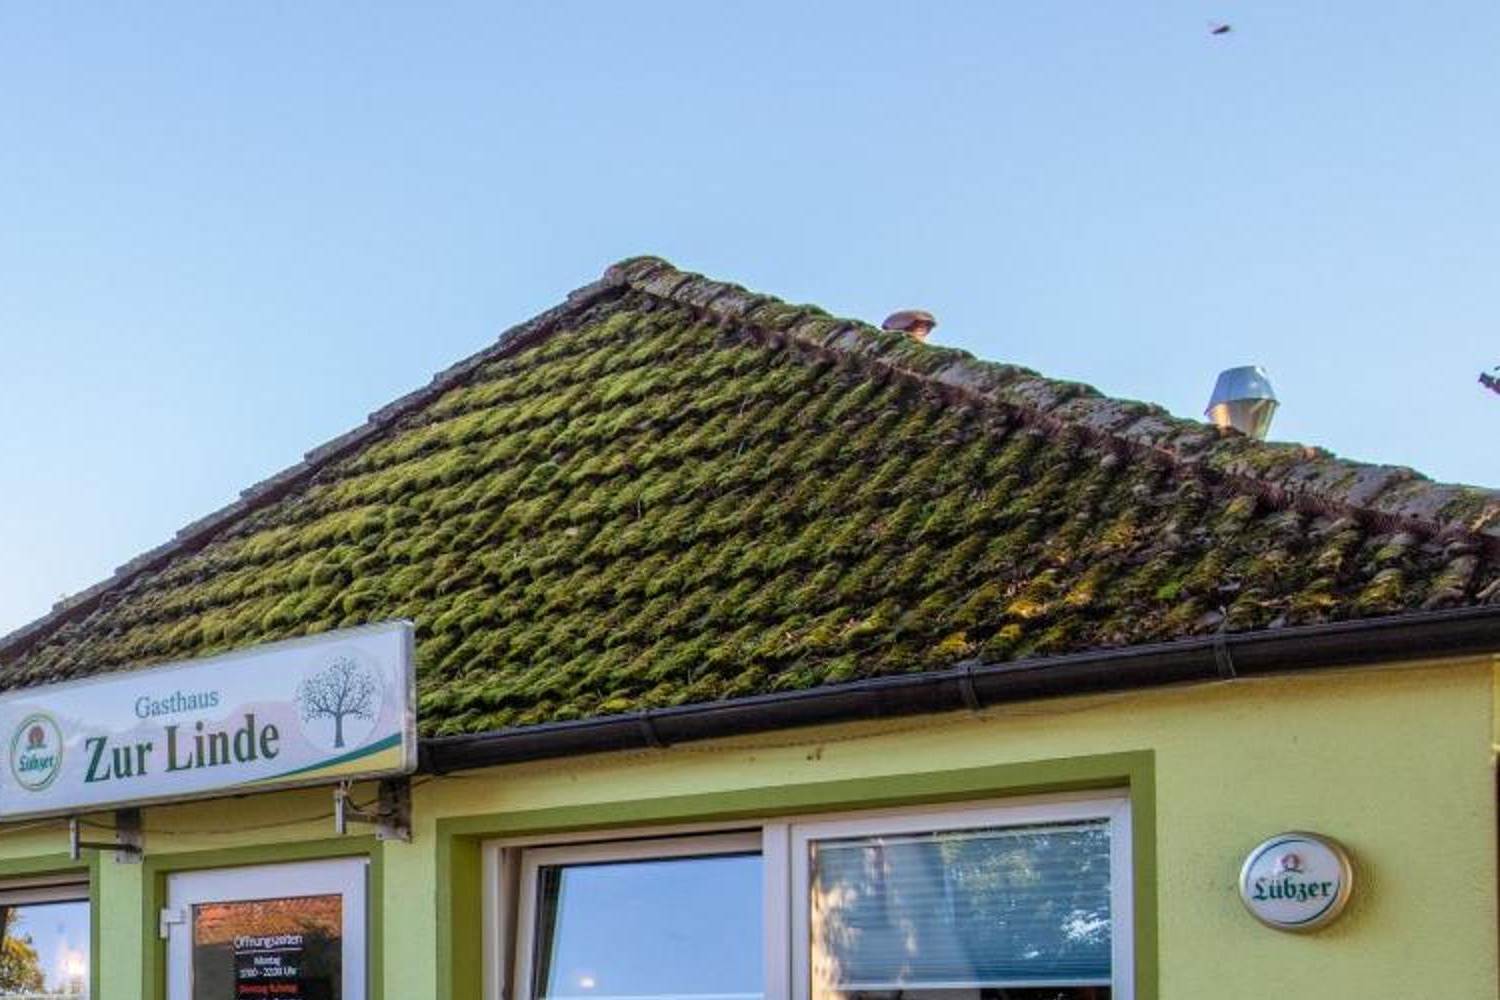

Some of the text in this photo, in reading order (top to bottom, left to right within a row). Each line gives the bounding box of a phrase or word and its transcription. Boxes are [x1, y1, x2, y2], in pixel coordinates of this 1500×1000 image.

[134, 690, 220, 719] Gasthaus
[83, 713, 280, 784] Zur Linde
[1252, 877, 1333, 902] Lübzer
